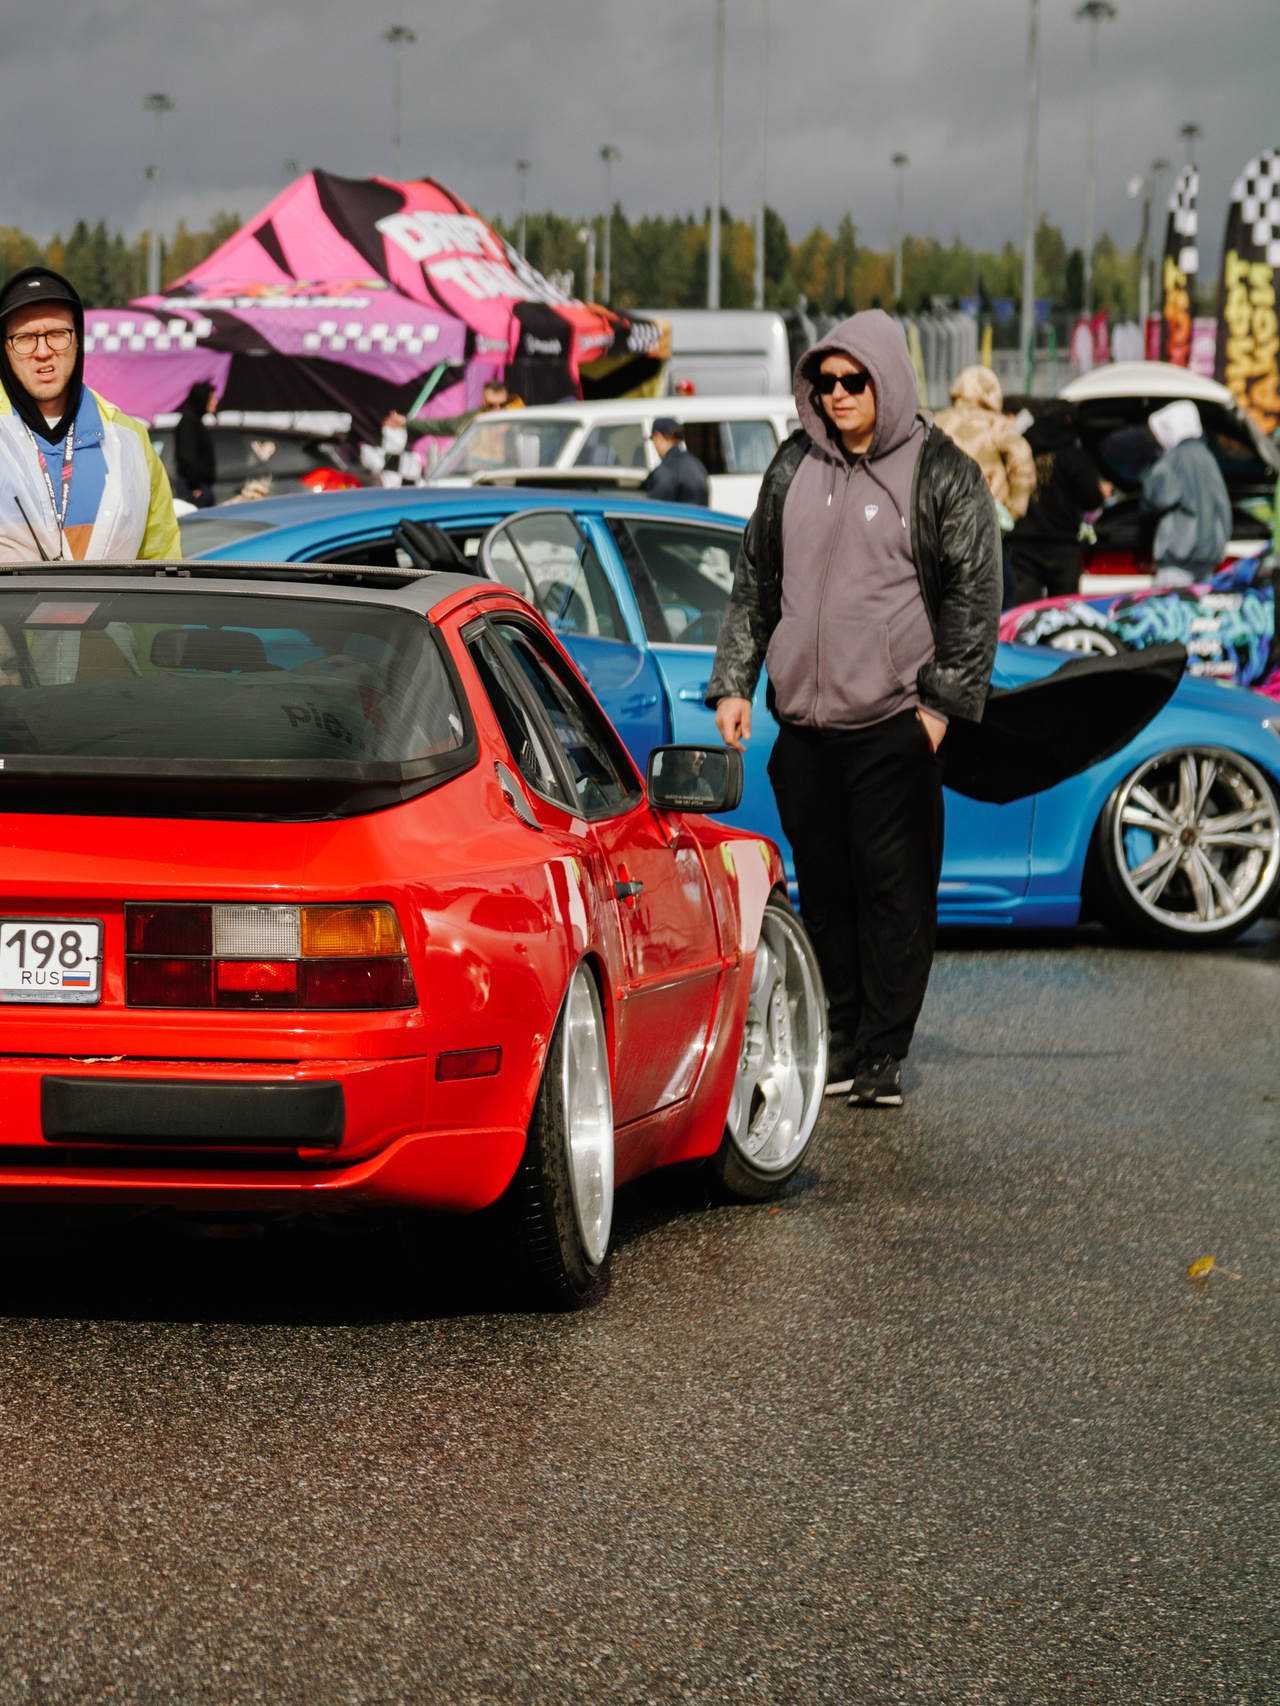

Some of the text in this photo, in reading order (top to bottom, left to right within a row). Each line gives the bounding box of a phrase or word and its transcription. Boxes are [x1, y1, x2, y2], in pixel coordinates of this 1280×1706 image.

[375, 211, 504, 262] DRIFT
[6, 929, 82, 969] 198
[21, 970, 60, 986] RUS
